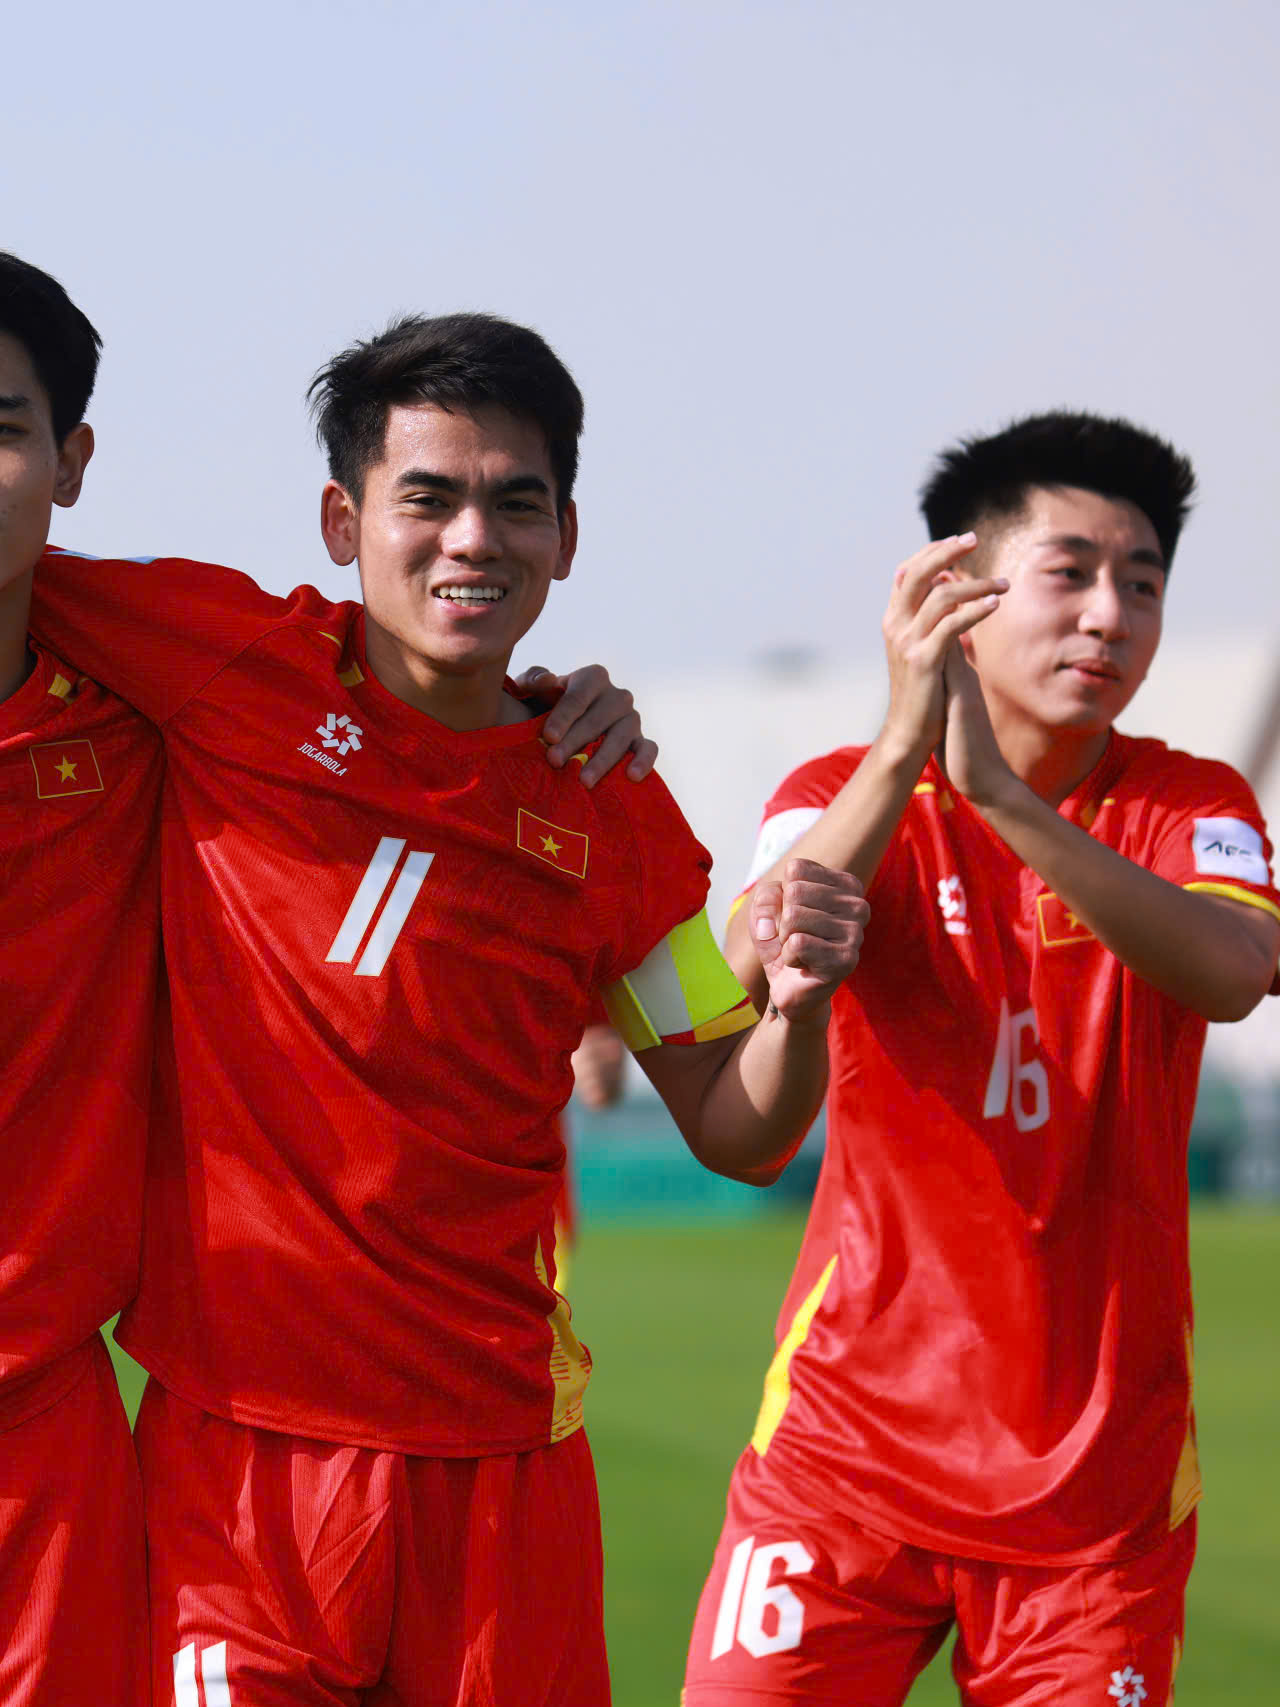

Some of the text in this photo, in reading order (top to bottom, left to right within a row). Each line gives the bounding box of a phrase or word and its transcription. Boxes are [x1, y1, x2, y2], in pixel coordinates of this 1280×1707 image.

[297, 742, 348, 776] JOGARBOLA
[325, 837, 435, 977] 11
[984, 996, 1050, 1132] 16
[711, 1536, 814, 1661] 16
